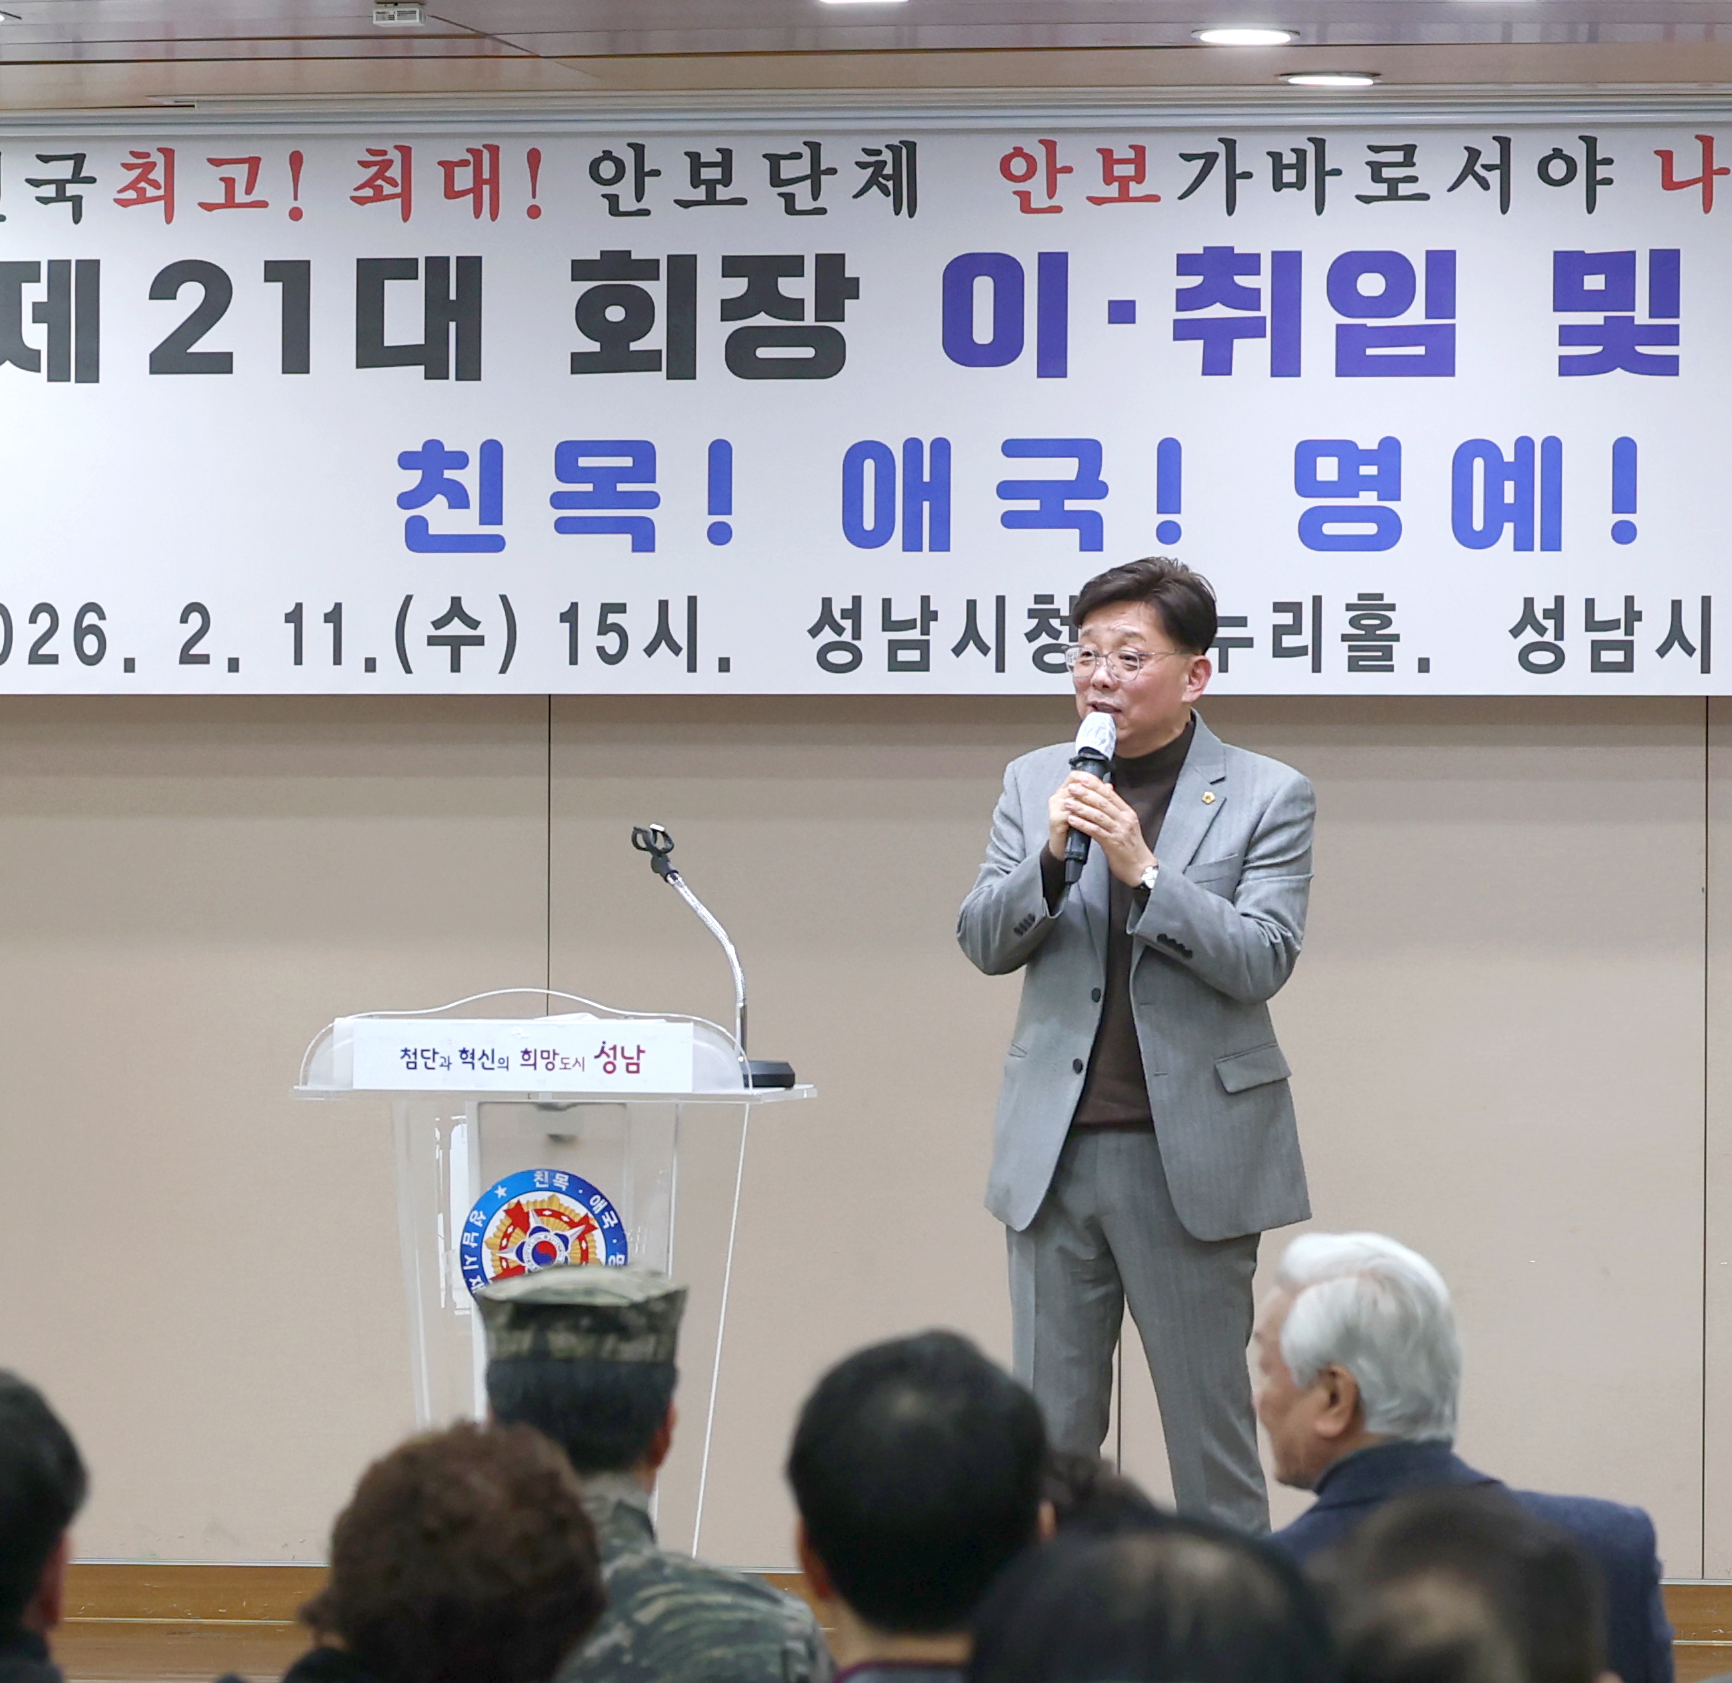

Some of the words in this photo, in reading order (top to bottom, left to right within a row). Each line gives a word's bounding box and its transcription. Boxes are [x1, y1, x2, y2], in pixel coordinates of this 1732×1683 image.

[349, 141, 542, 224] 최대!
[588, 138, 918, 220] 안보단체
[569, 250, 861, 381] 회장
[941, 246, 1457, 379] 이·취임
[1552, 249, 1681, 378] 및
[396, 438, 733, 554] 친목!
[841, 436, 1183, 553] 애국!
[1293, 435, 1638, 553] 명예!
[178, 601, 240, 674] 2.
[558, 594, 731, 674] 15시.
[1208, 592, 1431, 674] 누리홀.
[1508, 594, 1712, 675] 성남시
[399, 1046, 453, 1072] 첨단과
[458, 1046, 510, 1072] 혁신의
[520, 1047, 585, 1072] 희망도시
[593, 1040, 646, 1075] 성남
[533, 1171, 570, 1192] 친목
[589, 1194, 619, 1229] 애국
